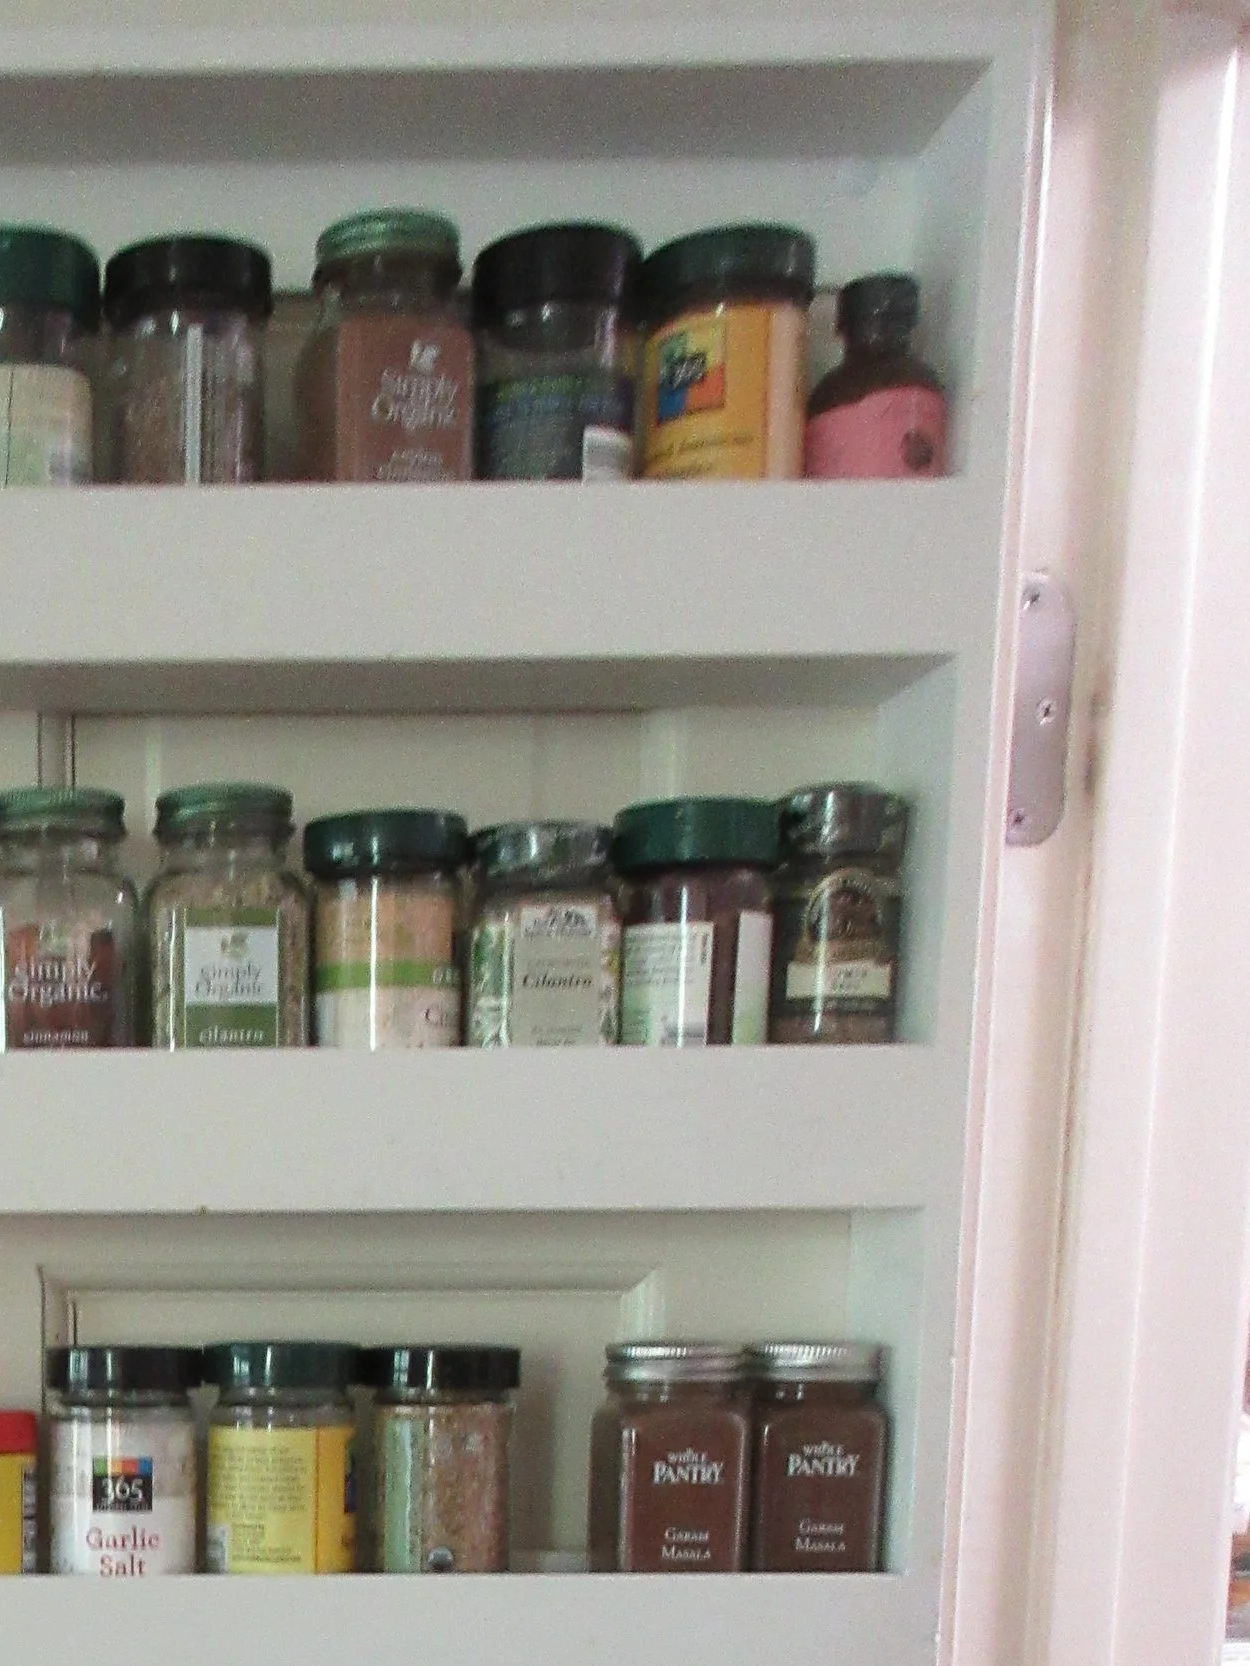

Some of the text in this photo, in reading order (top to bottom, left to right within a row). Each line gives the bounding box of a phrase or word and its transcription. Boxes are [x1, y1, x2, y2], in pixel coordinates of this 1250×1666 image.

[653, 1460, 725, 1485] PANTRY
[786, 1453, 860, 1478] PANTRY
[103, 1476, 144, 1503] 365
[86, 1525, 162, 1552] Garlic
[99, 1553, 147, 1577] Salt
